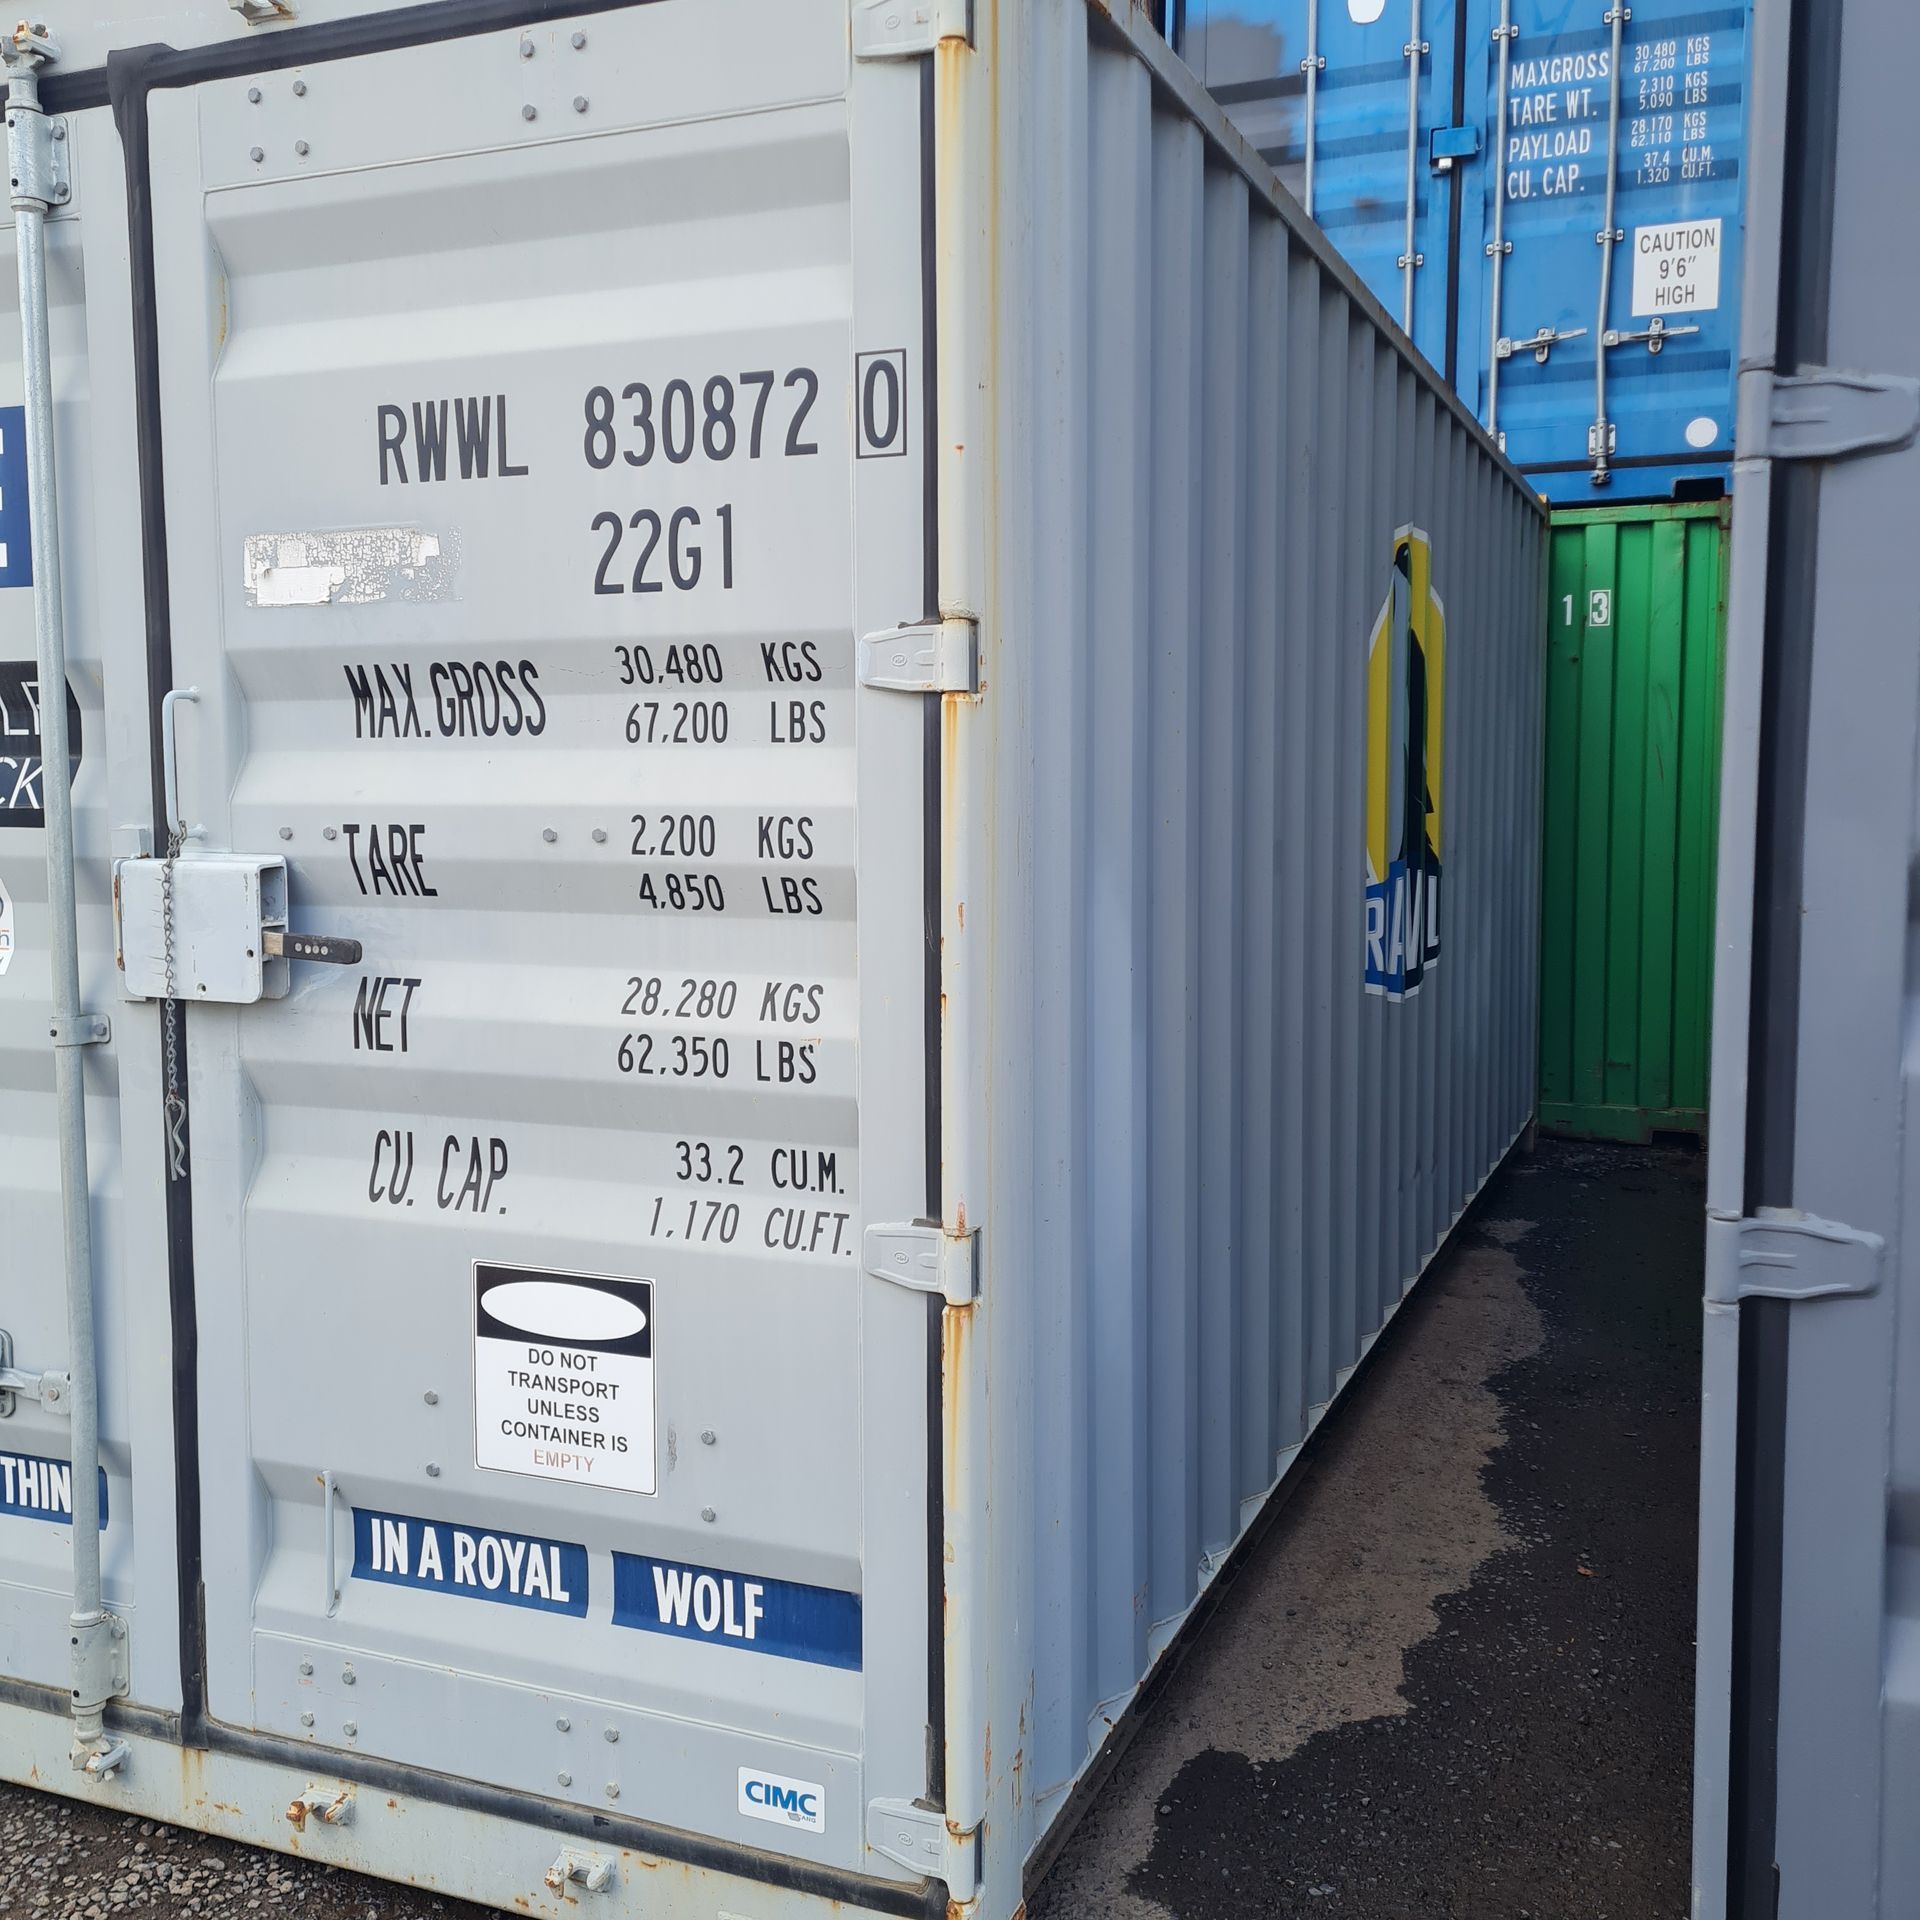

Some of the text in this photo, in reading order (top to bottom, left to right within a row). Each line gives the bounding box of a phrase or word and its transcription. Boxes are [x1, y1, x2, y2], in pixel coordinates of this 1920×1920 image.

[1686, 52, 1709, 66] LBS
[1687, 36, 1710, 54] KGS
[1512, 52, 1609, 90] MAXGROSS
[1685, 71, 1708, 88] KGS
[1510, 88, 1598, 127] TARE WT.
[1684, 87, 1707, 104] LBS
[1683, 127, 1706, 142] LBS
[1684, 112, 1706, 128] KGS
[1508, 128, 1591, 163] PAYLOAD
[1644, 150, 1670, 168] 37.4
[1507, 166, 1586, 200] CU. CAP.
[1640, 227, 1716, 254] CAUTION
[1654, 284, 1696, 306] HIGH
[377, 394, 529, 486] RWWL
[584, 367, 820, 470] 830872
[591, 504, 733, 595] 22G1
[760, 641, 822, 682] KGS
[770, 701, 826, 744] LBS
[758, 816, 814, 860] KGS
[342, 824, 438, 898] TARE
[763, 876, 822, 915] LBS
[353, 976, 422, 1052] NET
[759, 982, 824, 1024] KGS
[756, 1040, 816, 1085] LBS
[369, 1129, 508, 1215] CU. CAP.
[675, 1141, 845, 1195] 33.2 CU.M.
[763, 1208, 854, 1257] CU.FT.
[528, 1348, 598, 1372] DO NOT
[508, 1370, 620, 1401] TRANSPORT
[528, 1398, 600, 1424] UNLESS
[501, 1419, 628, 1453] CONTAINER IS
[534, 1449, 594, 1473] EMPTY
[370, 1518, 764, 1640] IN A ROYAL WOLF
[745, 1781, 816, 1816] CIMC
